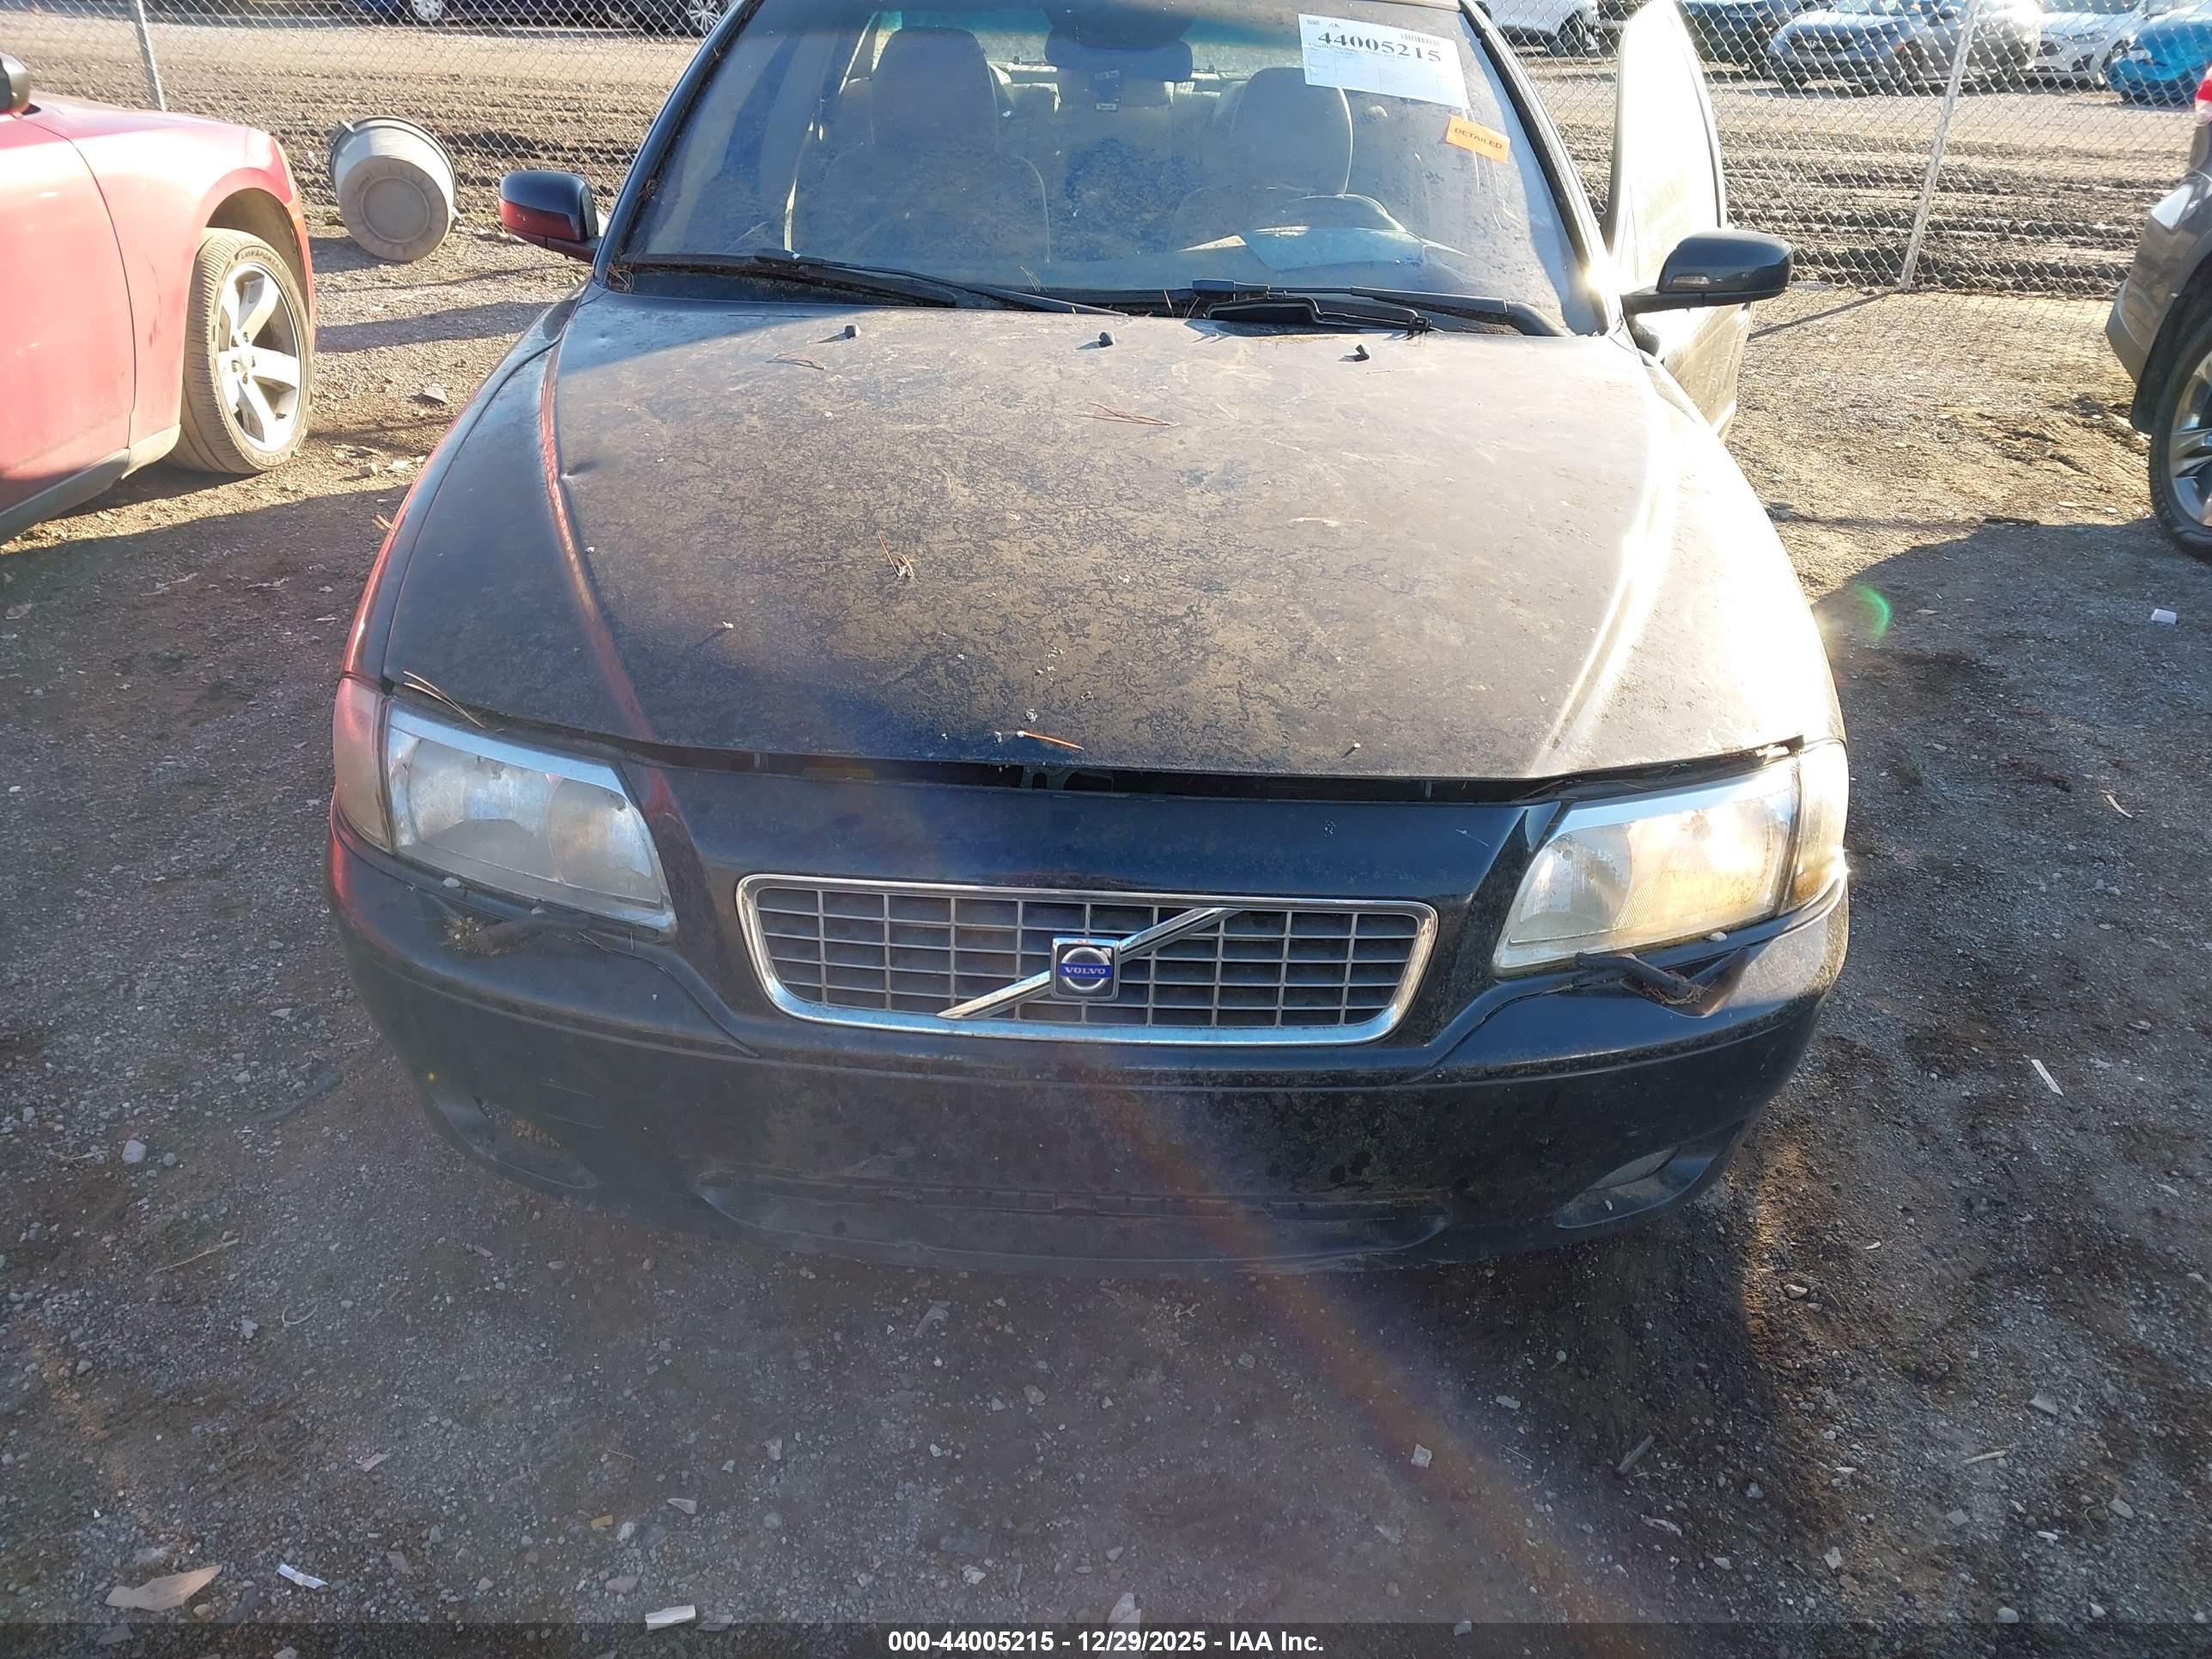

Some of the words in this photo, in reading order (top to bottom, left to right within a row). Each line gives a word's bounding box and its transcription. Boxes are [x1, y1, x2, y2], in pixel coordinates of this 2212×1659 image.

[1318, 31, 1442, 63] 44005215
[1454, 127, 1503, 149] DETAILED
[1064, 966, 1107, 975] VOLVO
